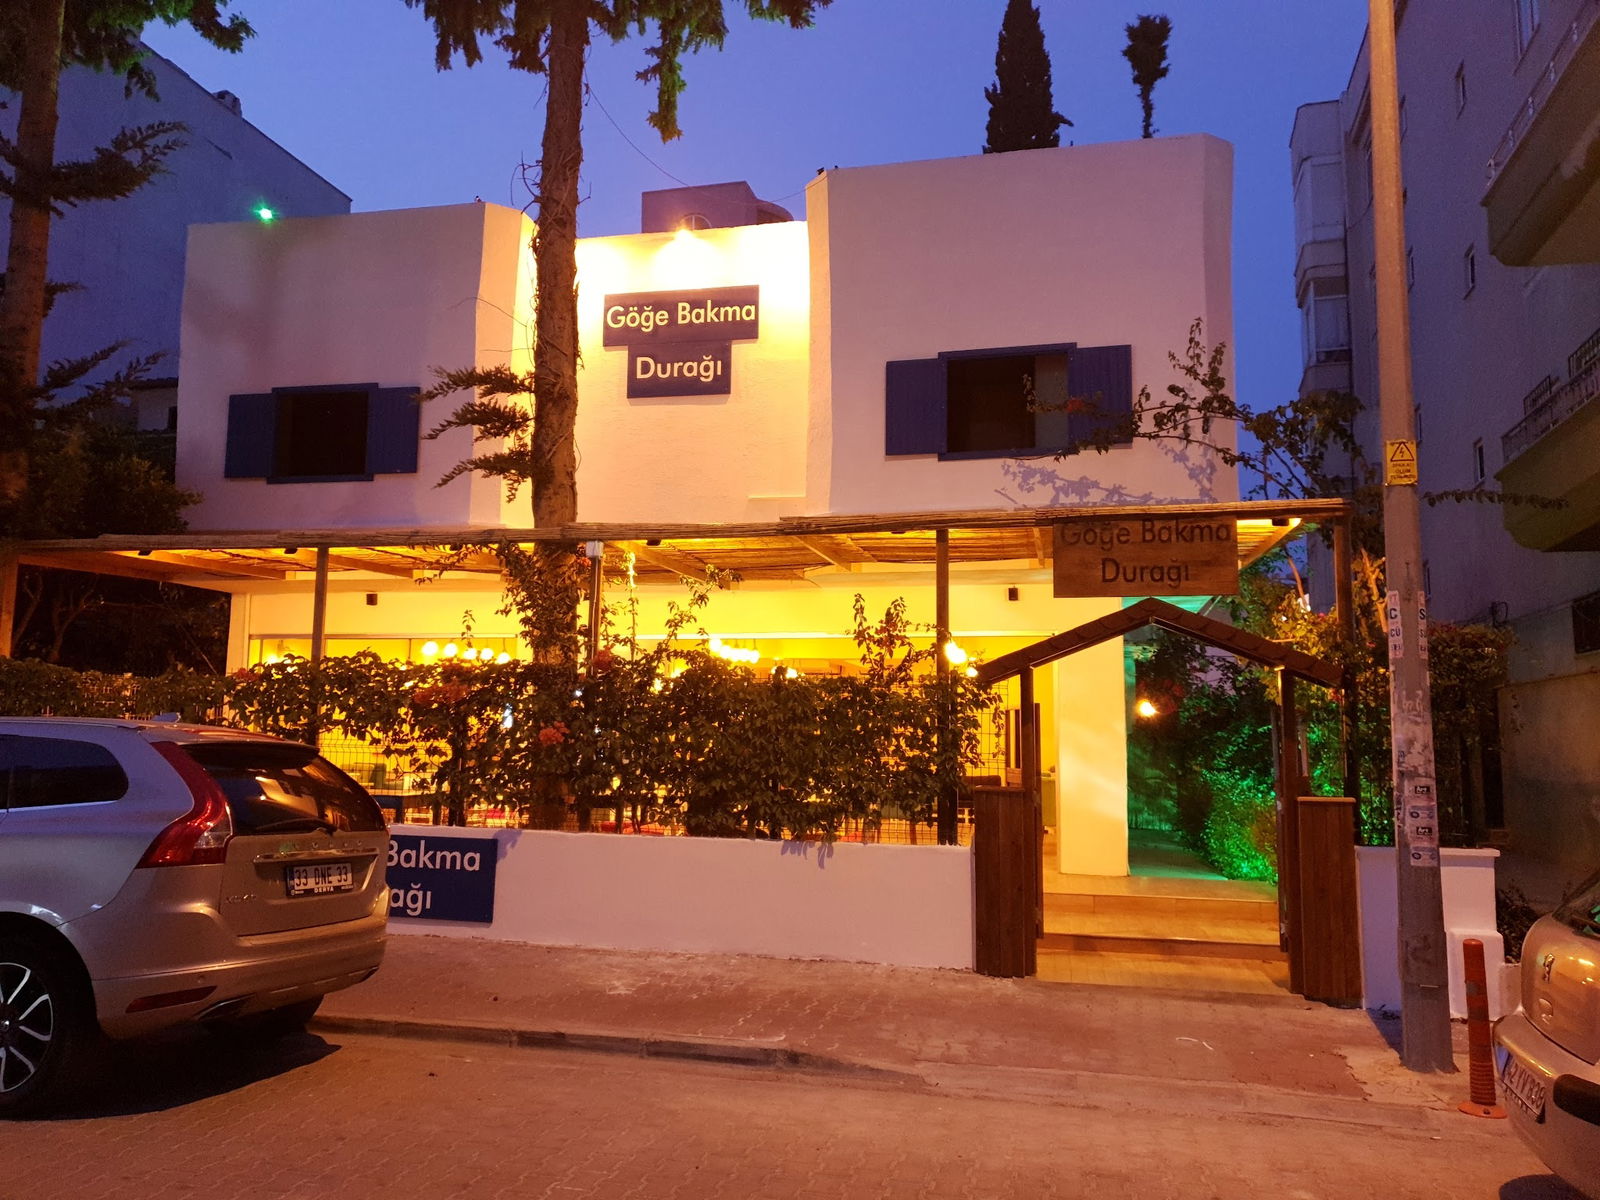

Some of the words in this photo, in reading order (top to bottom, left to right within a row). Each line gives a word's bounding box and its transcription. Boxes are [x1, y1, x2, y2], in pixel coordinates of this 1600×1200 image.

[606, 305, 669, 332] Göğe
[678, 300, 756, 324] Bakma
[636, 355, 722, 382] Durağı
[1060, 521, 1131, 550] Göğe
[1141, 519, 1231, 544] Bakma
[1102, 558, 1189, 588] Durağı
[387, 840, 480, 871] Bakma
[295, 869, 308, 887] 33
[337, 866, 348, 883] 33
